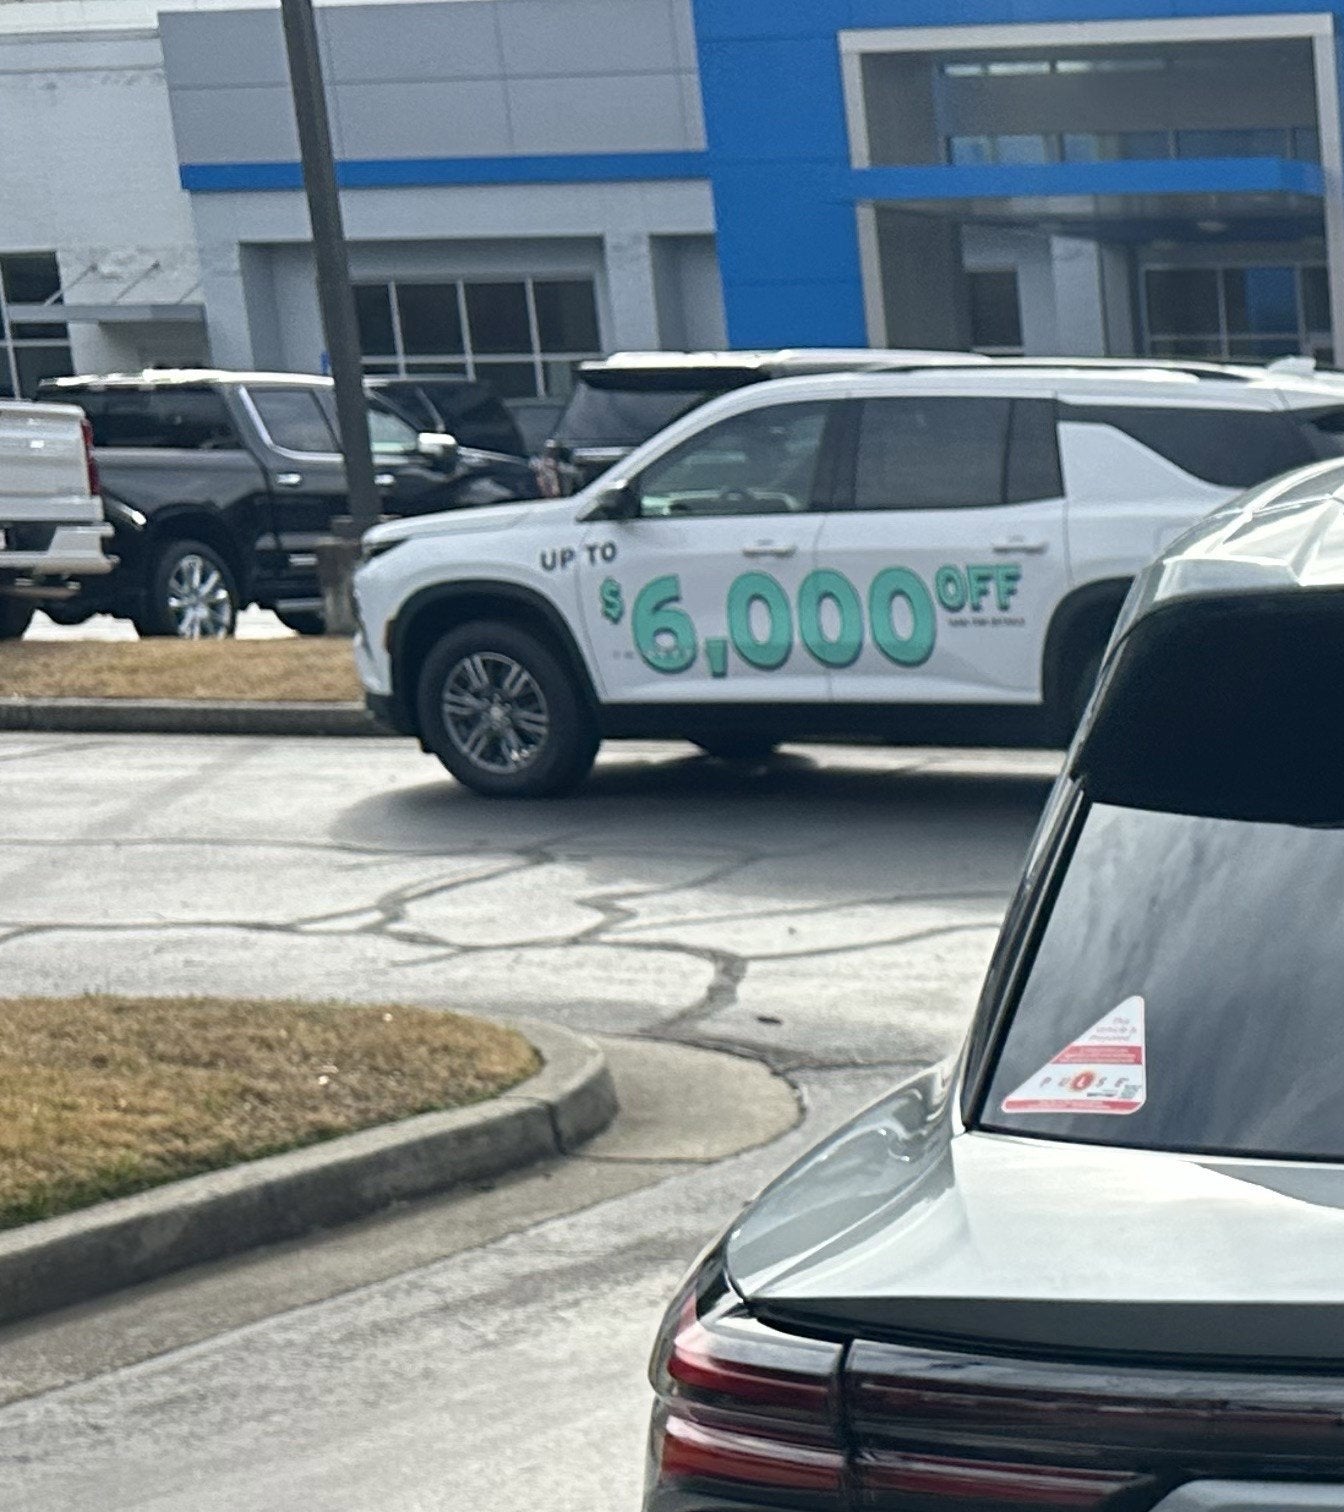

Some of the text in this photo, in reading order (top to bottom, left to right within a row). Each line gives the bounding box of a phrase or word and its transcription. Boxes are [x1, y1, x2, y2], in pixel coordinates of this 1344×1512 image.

[541, 541, 617, 571] UP TO
[935, 564, 1022, 613] OFF
